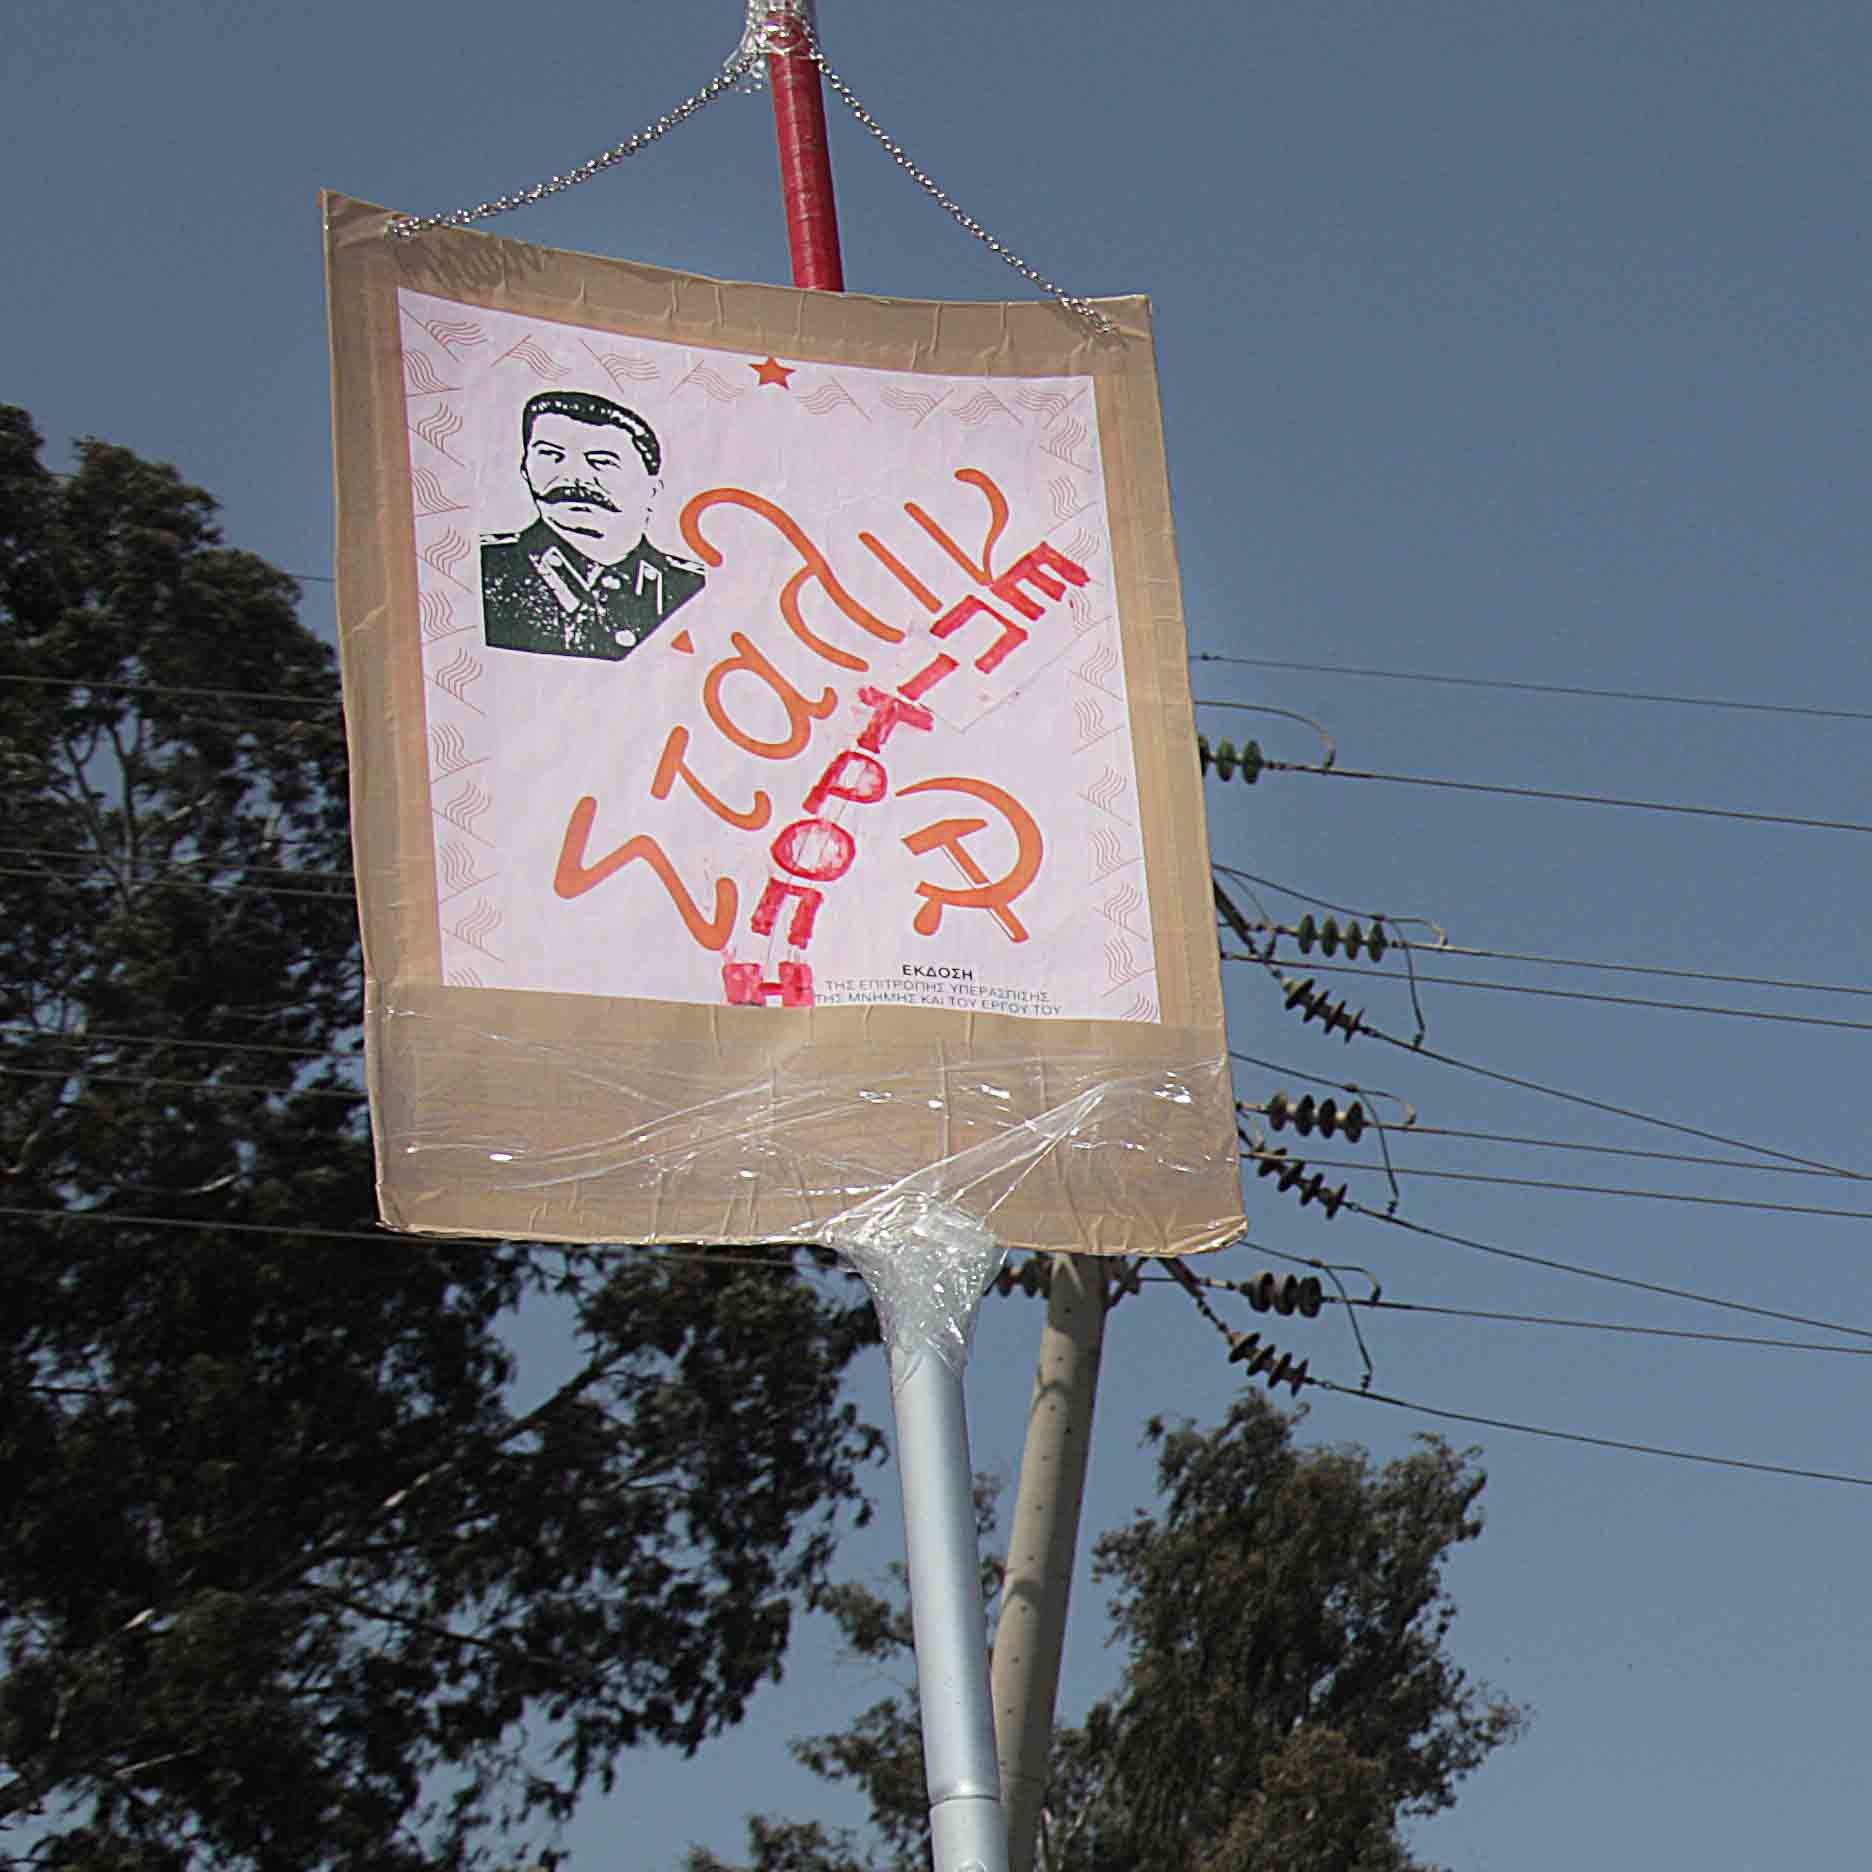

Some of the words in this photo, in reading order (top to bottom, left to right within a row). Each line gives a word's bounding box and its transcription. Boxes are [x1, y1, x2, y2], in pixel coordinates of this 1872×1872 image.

[552, 467, 1010, 951] Στάλιν
[902, 963, 974, 981] ΕΚΔΟΣΗ
[824, 979, 855, 992] ΤΗΣ
[859, 979, 945, 994] ΕΠΙΤΡΟΠΗΣ
